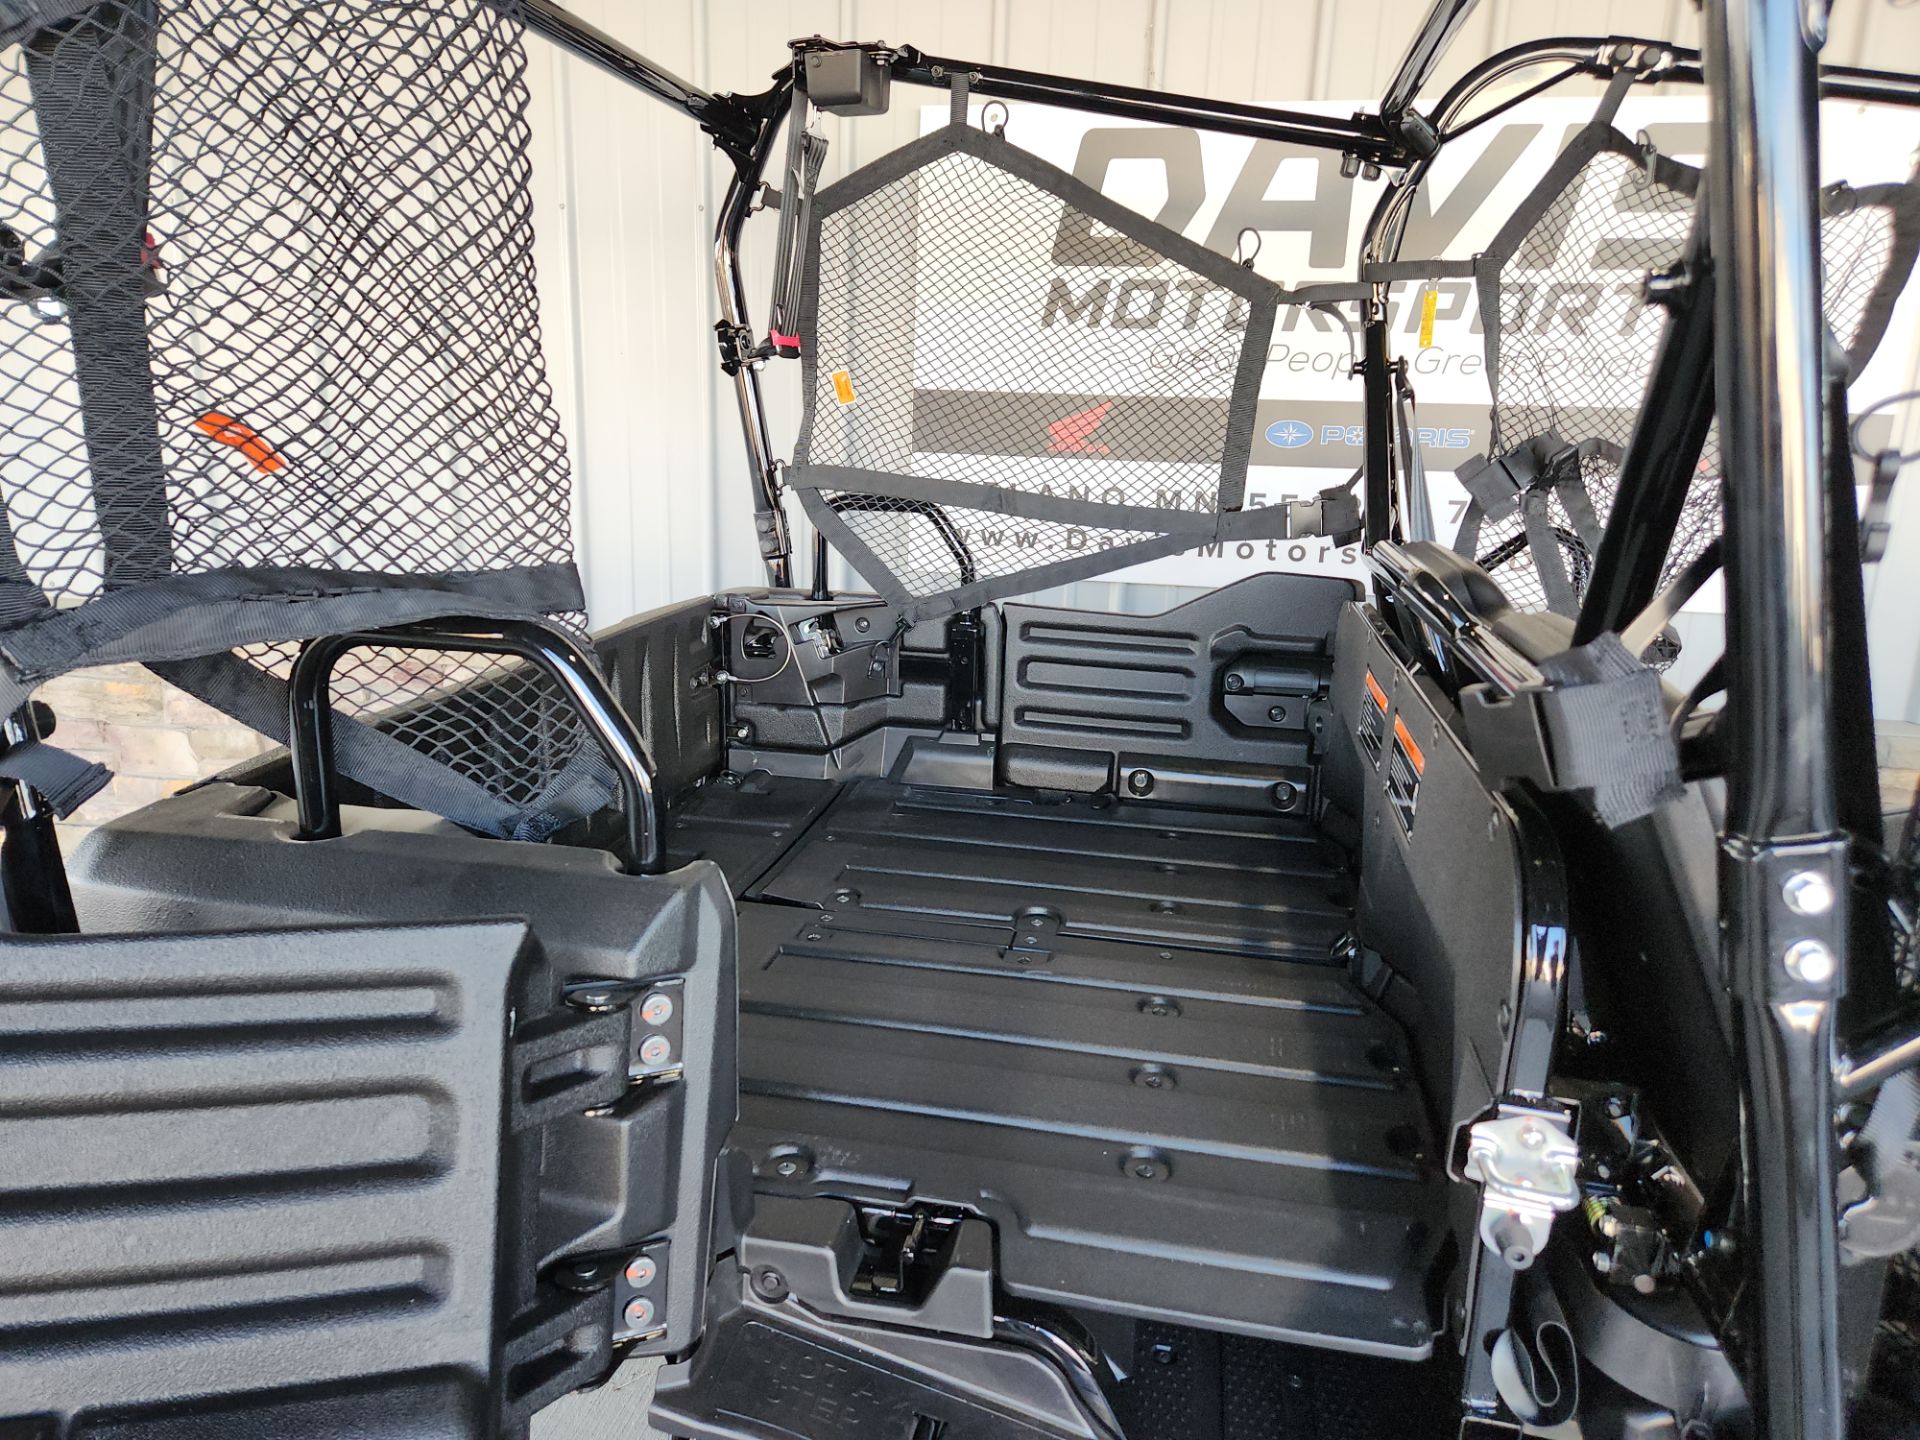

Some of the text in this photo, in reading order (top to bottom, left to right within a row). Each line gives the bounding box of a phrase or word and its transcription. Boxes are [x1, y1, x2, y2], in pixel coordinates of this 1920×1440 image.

[1041, 277, 1648, 336] MOTRPORT
[1150, 341, 1239, 371] Grea
[1265, 343, 1356, 380] Peop
[1321, 425, 1475, 449] PORIS
